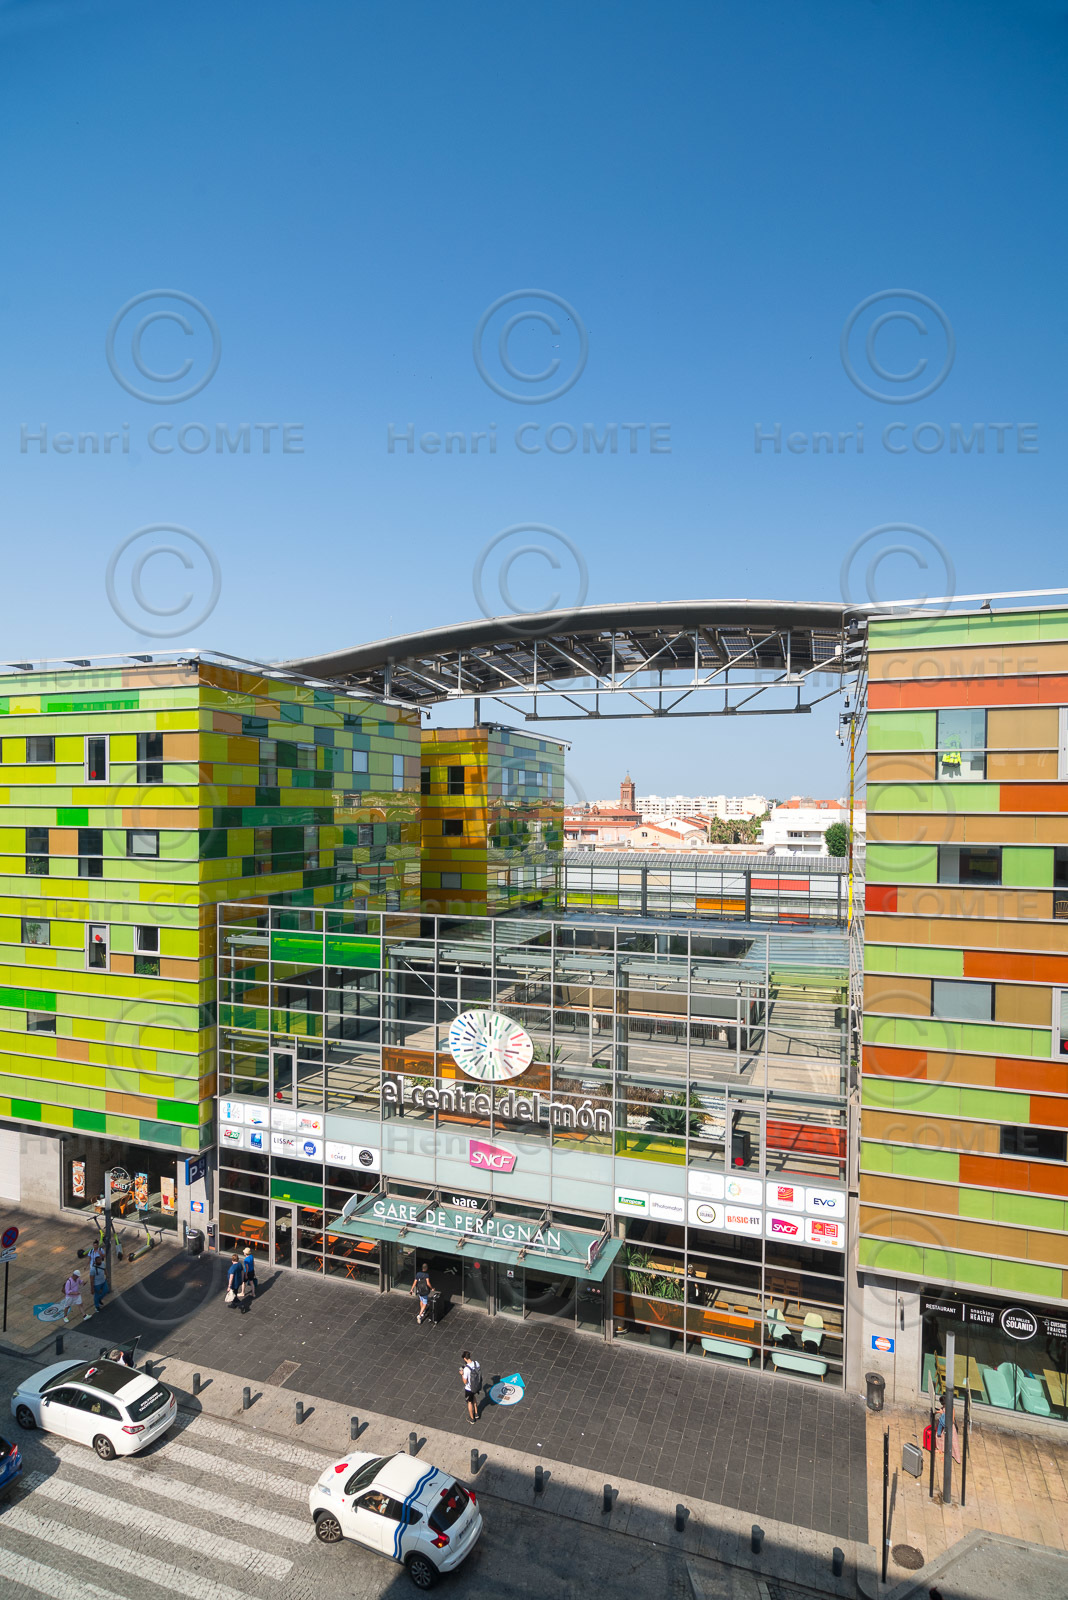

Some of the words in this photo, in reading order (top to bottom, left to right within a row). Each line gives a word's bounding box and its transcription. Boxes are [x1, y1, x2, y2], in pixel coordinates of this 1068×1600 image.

[382, 1075, 405, 1104] el
[411, 1085, 491, 1116] centre
[499, 1089, 541, 1123] del
[549, 1100, 613, 1133] món
[273, 1137, 295, 1147] LISSAC
[471, 1151, 513, 1168] SNCF
[189, 1165, 198, 1183] P
[654, 1202, 683, 1212] Photomaton
[813, 1197, 836, 1208] EVO
[372, 1200, 418, 1222] GARE
[425, 1210, 446, 1227] DE
[455, 1215, 561, 1247] PERPIGNAN
[773, 1223, 797, 1233] SNCF
[925, 1303, 957, 1314] RESTAURANT
[970, 1308, 995, 1318] snacking
[969, 1314, 995, 1324] HEALTHY
[1005, 1320, 1034, 1332] SOLANID
